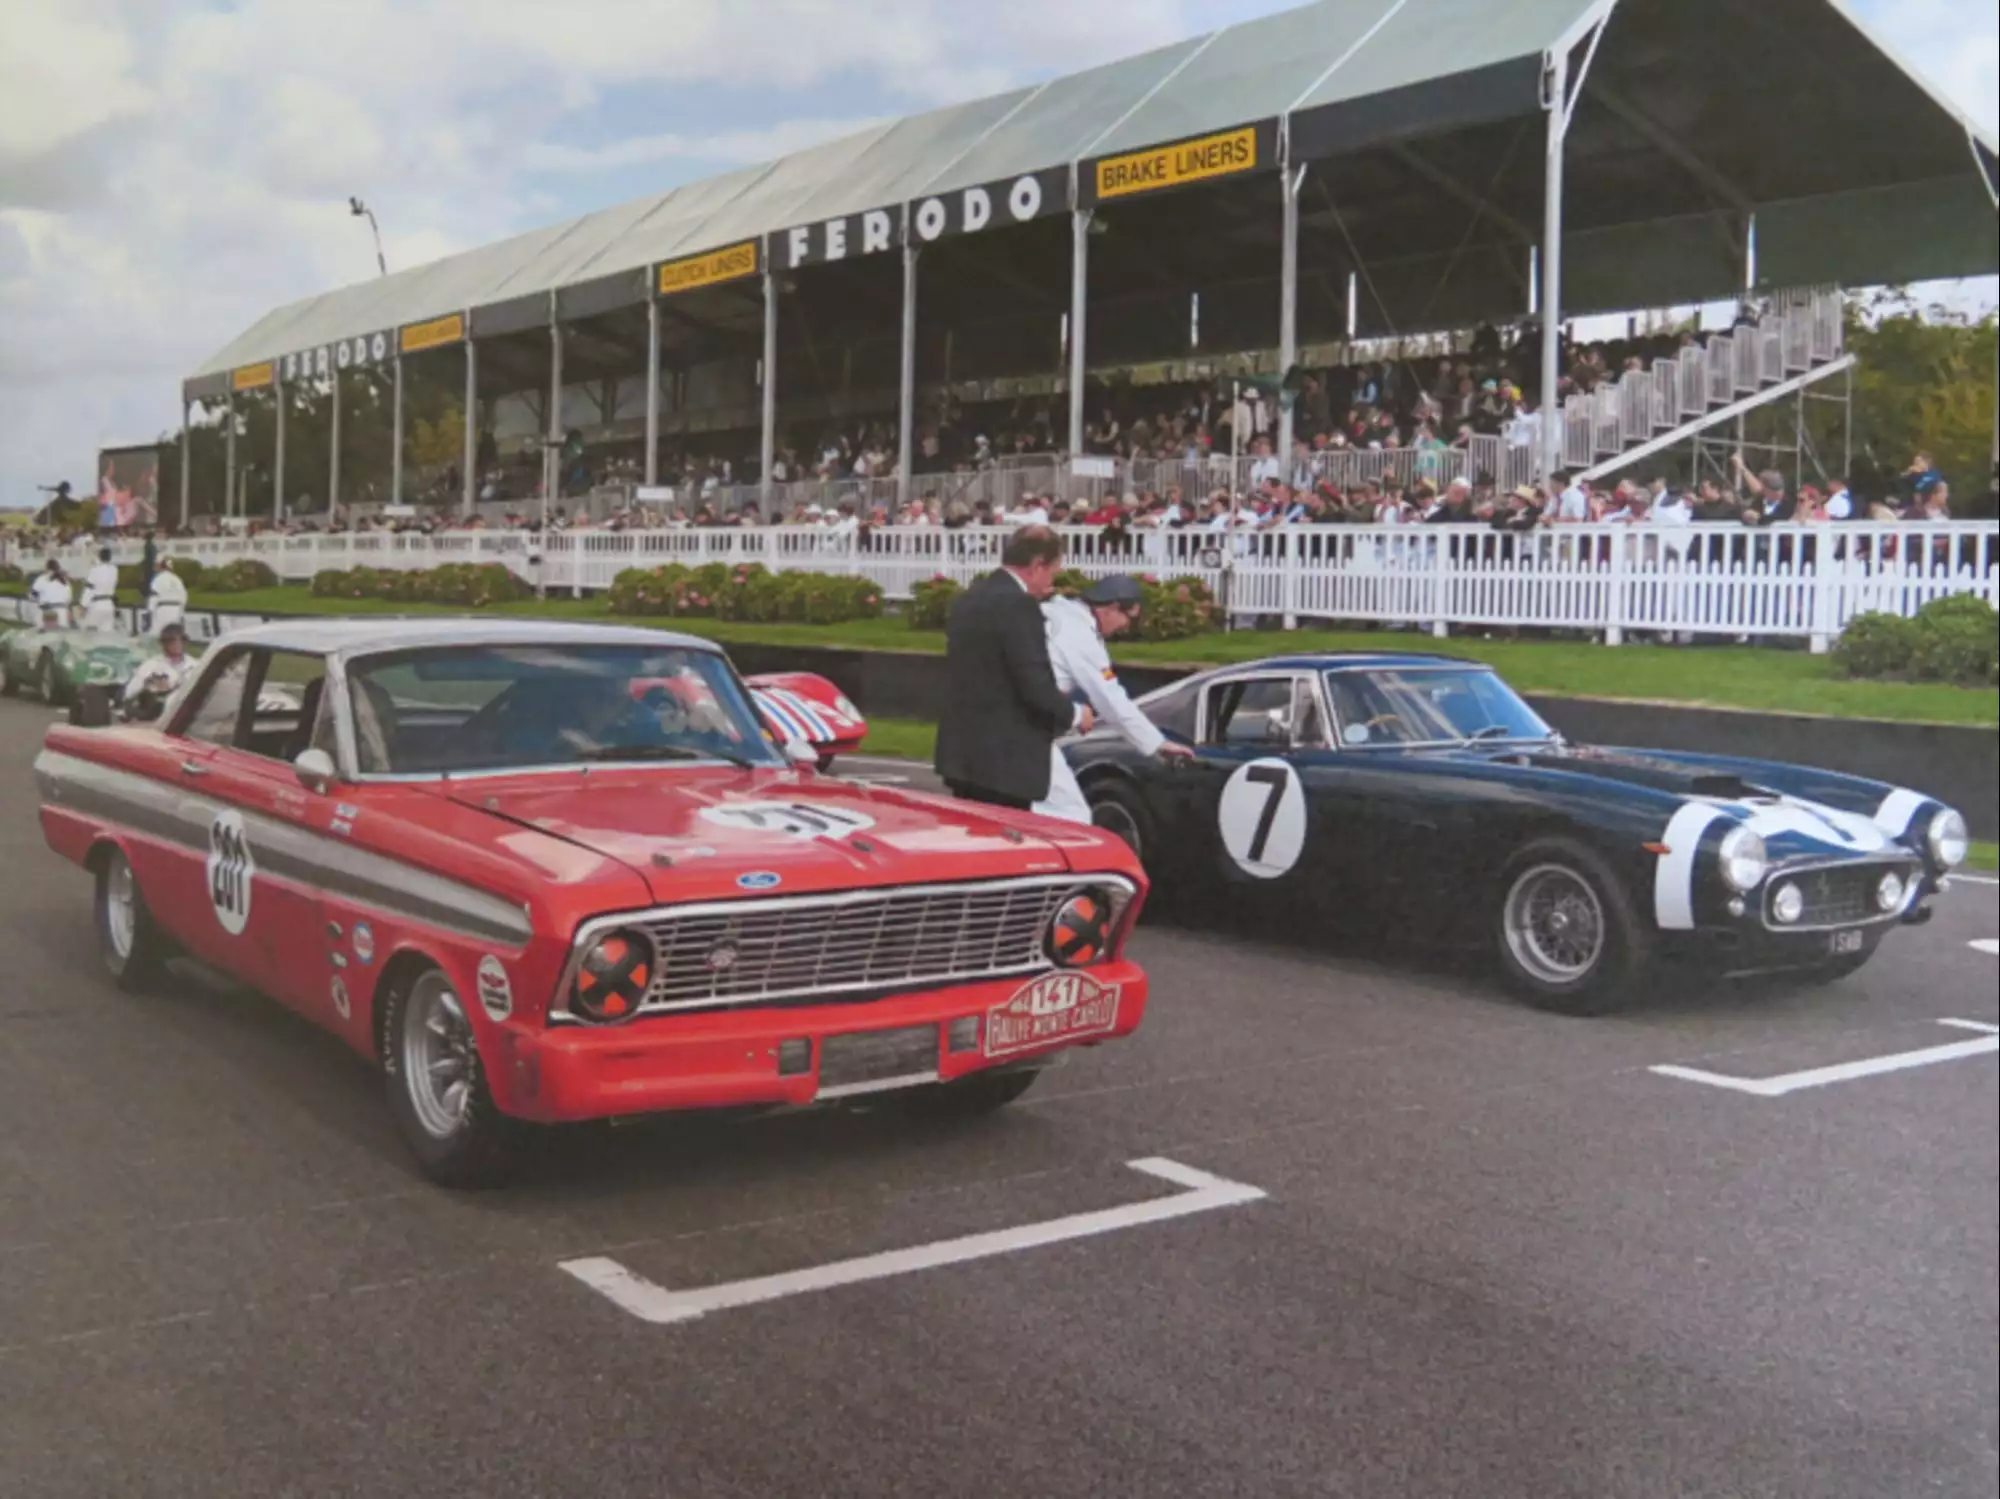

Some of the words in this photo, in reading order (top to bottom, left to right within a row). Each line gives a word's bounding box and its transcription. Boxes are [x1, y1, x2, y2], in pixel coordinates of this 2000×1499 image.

[1102, 154, 1167, 189] BRAKE
[1174, 136, 1249, 176] LINERS
[788, 175, 1042, 269] FERODO
[286, 331, 387, 382] FERODO
[1245, 765, 1289, 863] 7
[1035, 977, 1080, 1014] 141
[990, 1013, 1032, 1046] RALLYE
